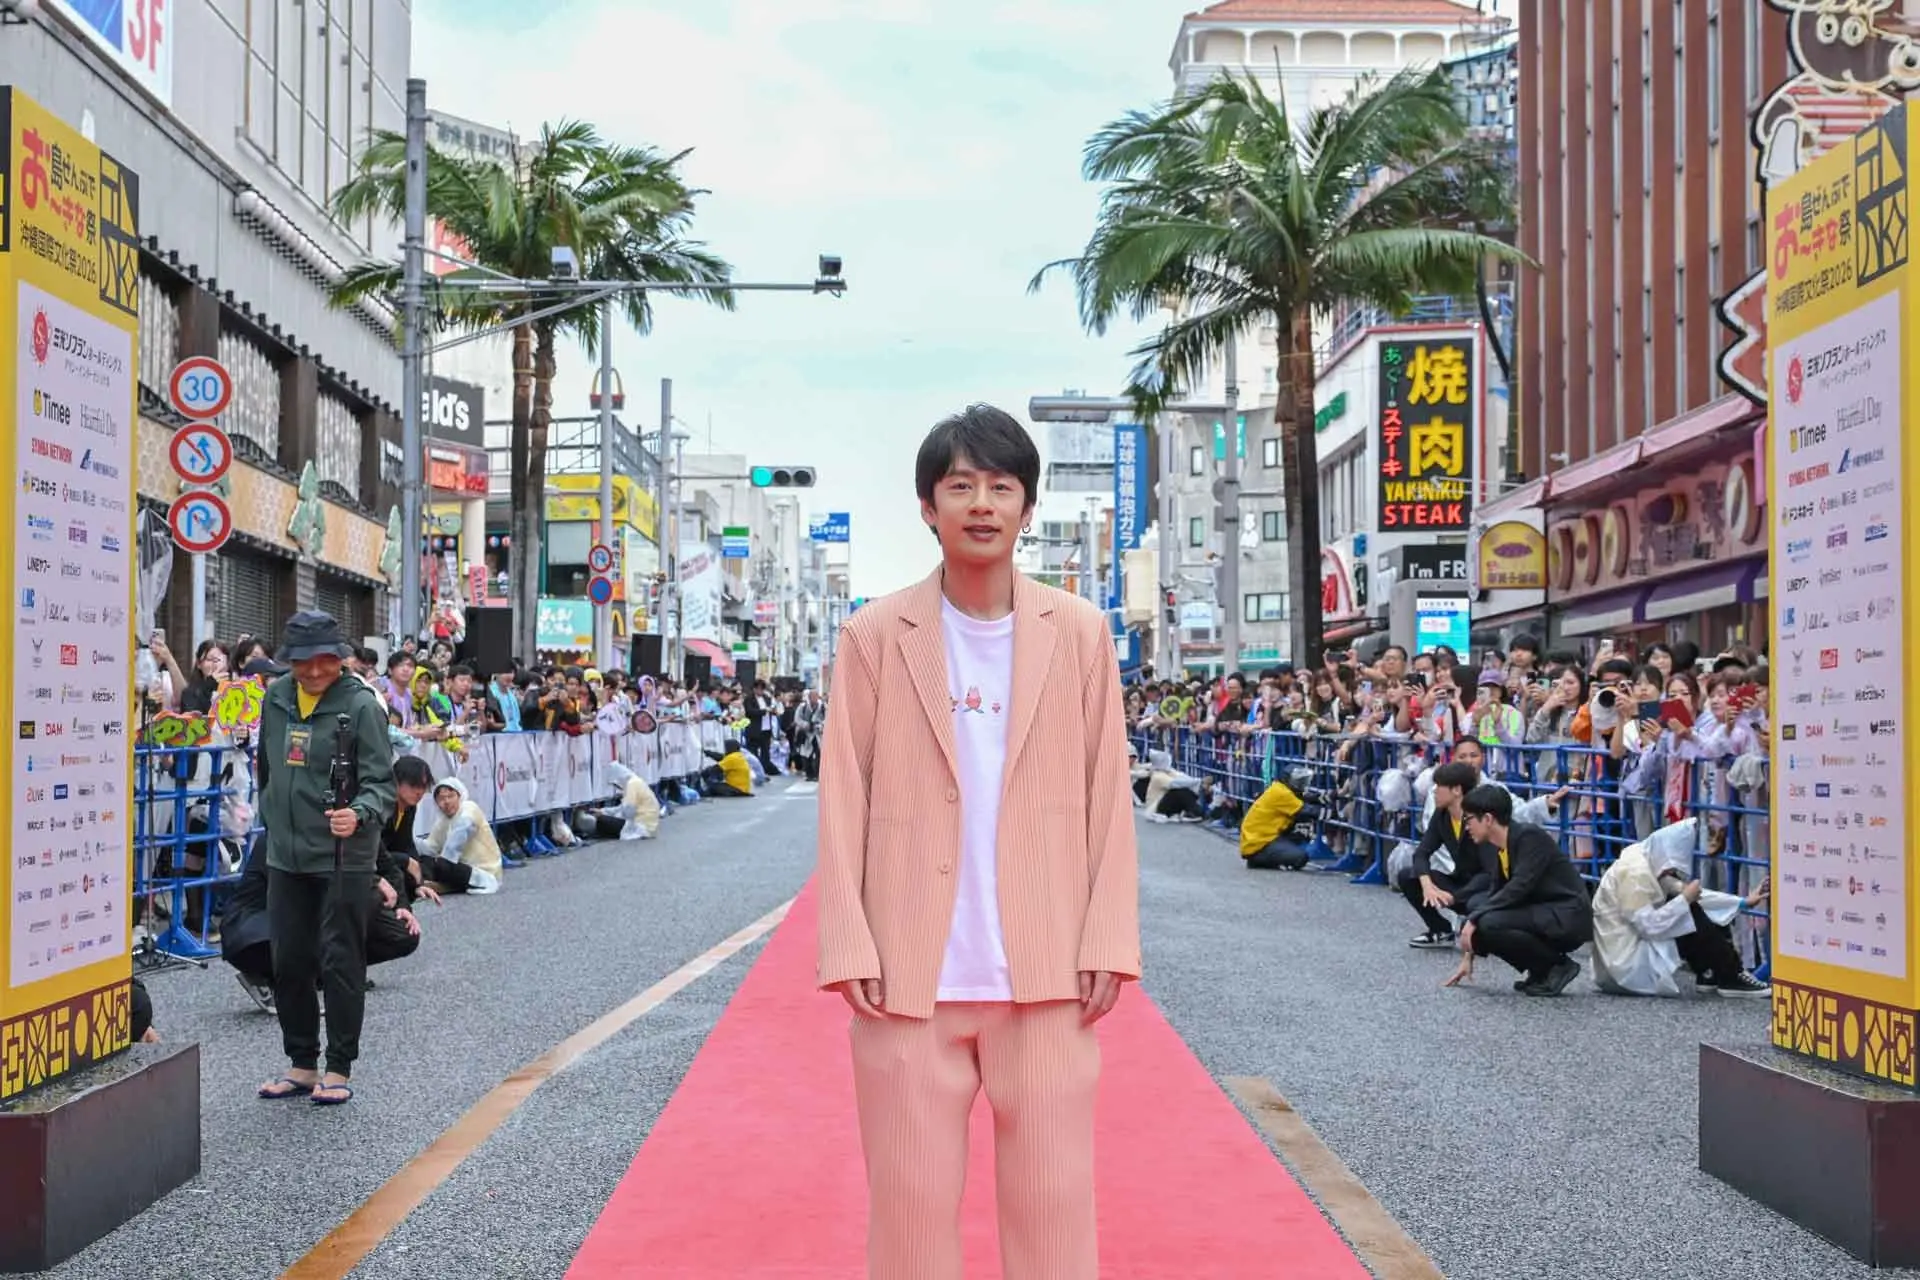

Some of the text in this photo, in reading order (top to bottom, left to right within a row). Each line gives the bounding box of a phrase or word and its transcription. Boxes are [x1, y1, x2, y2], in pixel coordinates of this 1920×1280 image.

[184, 376, 218, 402] 30
[43, 392, 71, 425] Timee
[1406, 345, 1468, 477] 焼肉
[1799, 423, 1827, 449] Timee
[1384, 480, 1464, 502] YAKINIKU
[1384, 503, 1464, 526] STEAK
[1409, 563, 1433, 578] I'm
[45, 723, 63, 736] DAM
